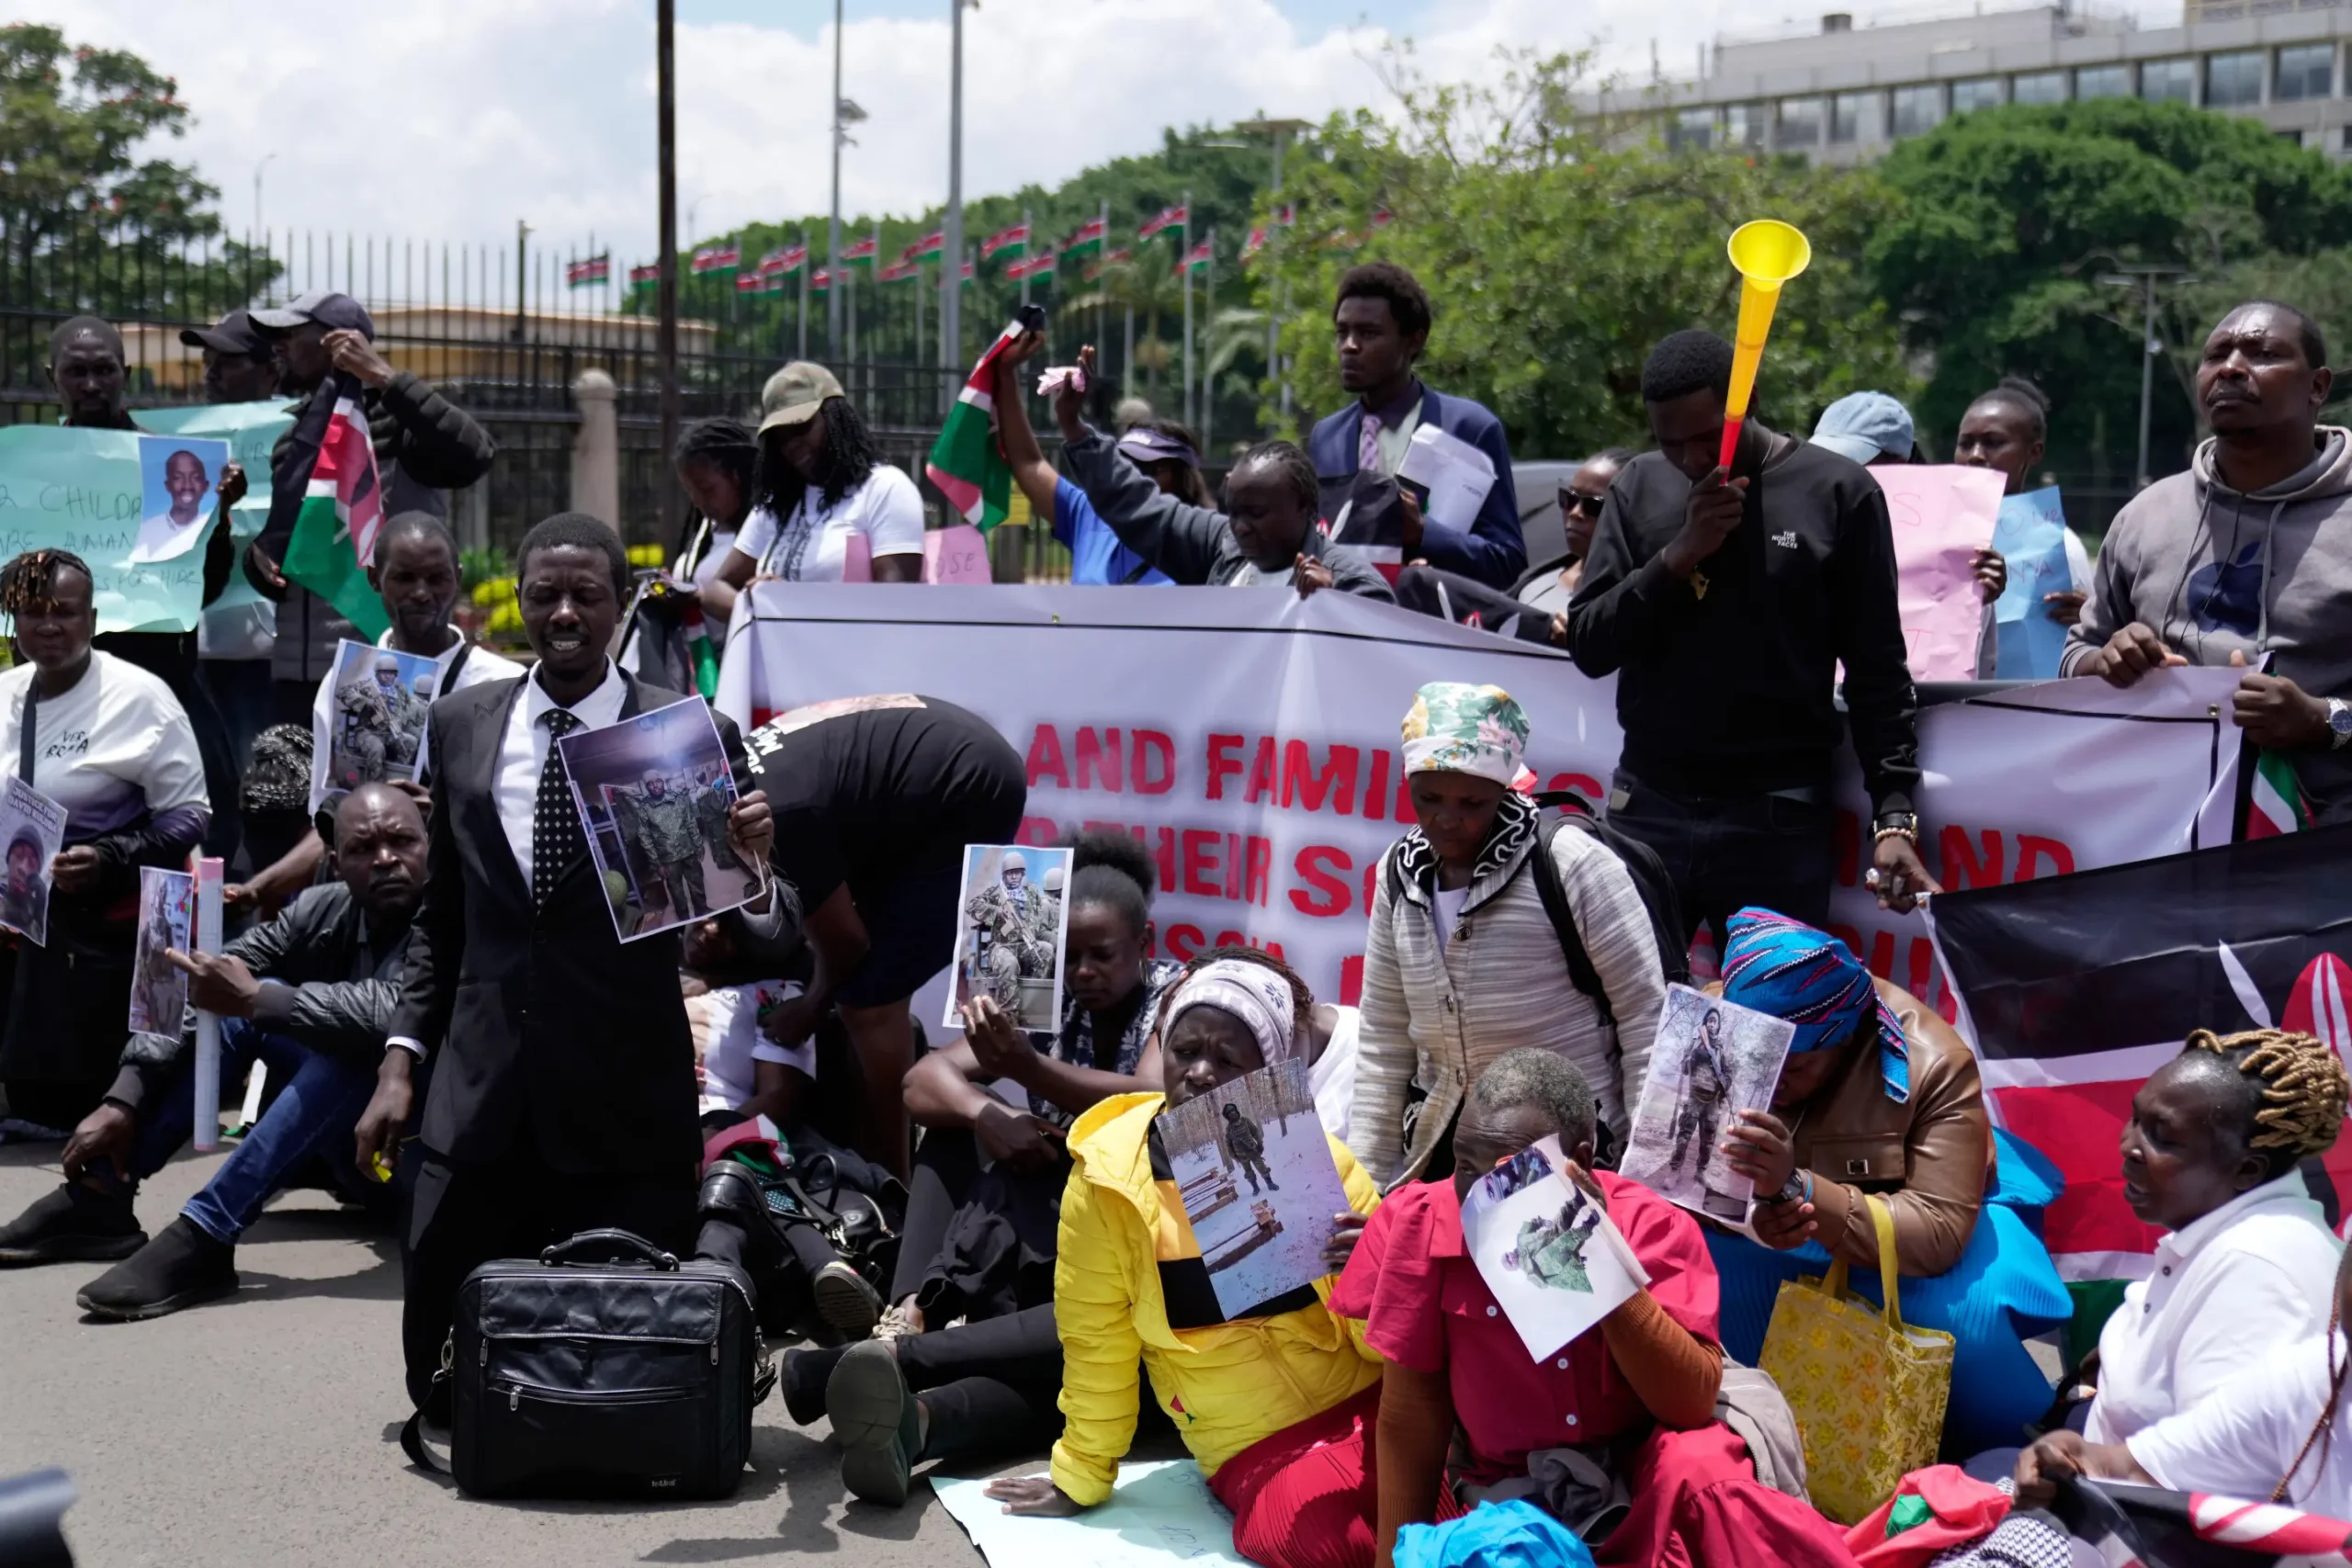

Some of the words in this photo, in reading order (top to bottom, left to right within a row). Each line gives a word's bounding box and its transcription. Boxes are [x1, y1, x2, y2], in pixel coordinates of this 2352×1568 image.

[1026, 724, 1175, 795] AND
[12, 786, 45, 812] JUSTICE
[43, 806, 58, 822] FOR
[1082, 820, 1272, 908] HEIR
